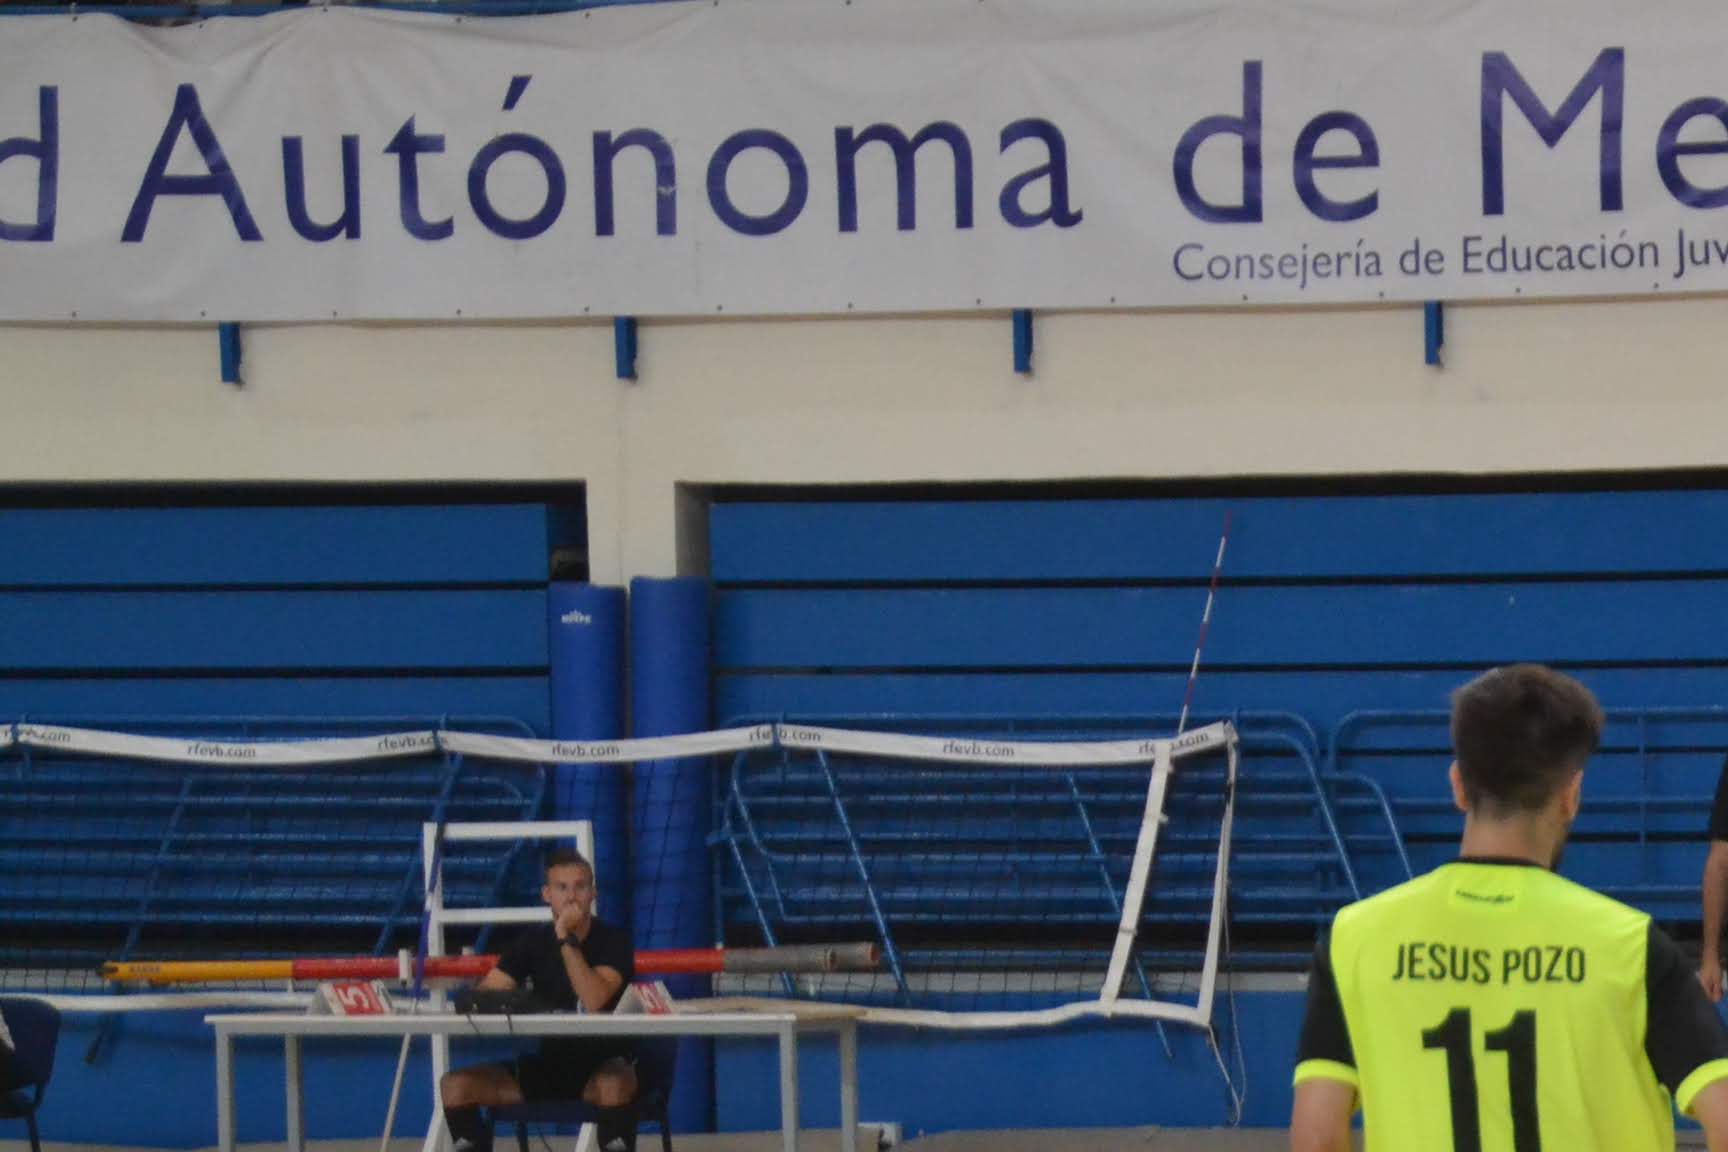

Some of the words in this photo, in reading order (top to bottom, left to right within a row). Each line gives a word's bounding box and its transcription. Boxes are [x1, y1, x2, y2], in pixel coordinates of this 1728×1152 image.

[120, 74, 1084, 243] Autónoma
[1171, 60, 1381, 225] de
[1173, 238, 1383, 290] Consejería
[1399, 238, 1445, 276] de
[1463, 229, 1660, 274] Educación
[551, 743, 621, 757] rfevb.com
[942, 742, 1015, 757] rfevb.com
[1391, 941, 1492, 986] JESUS
[1502, 945, 1586, 986] POZO
